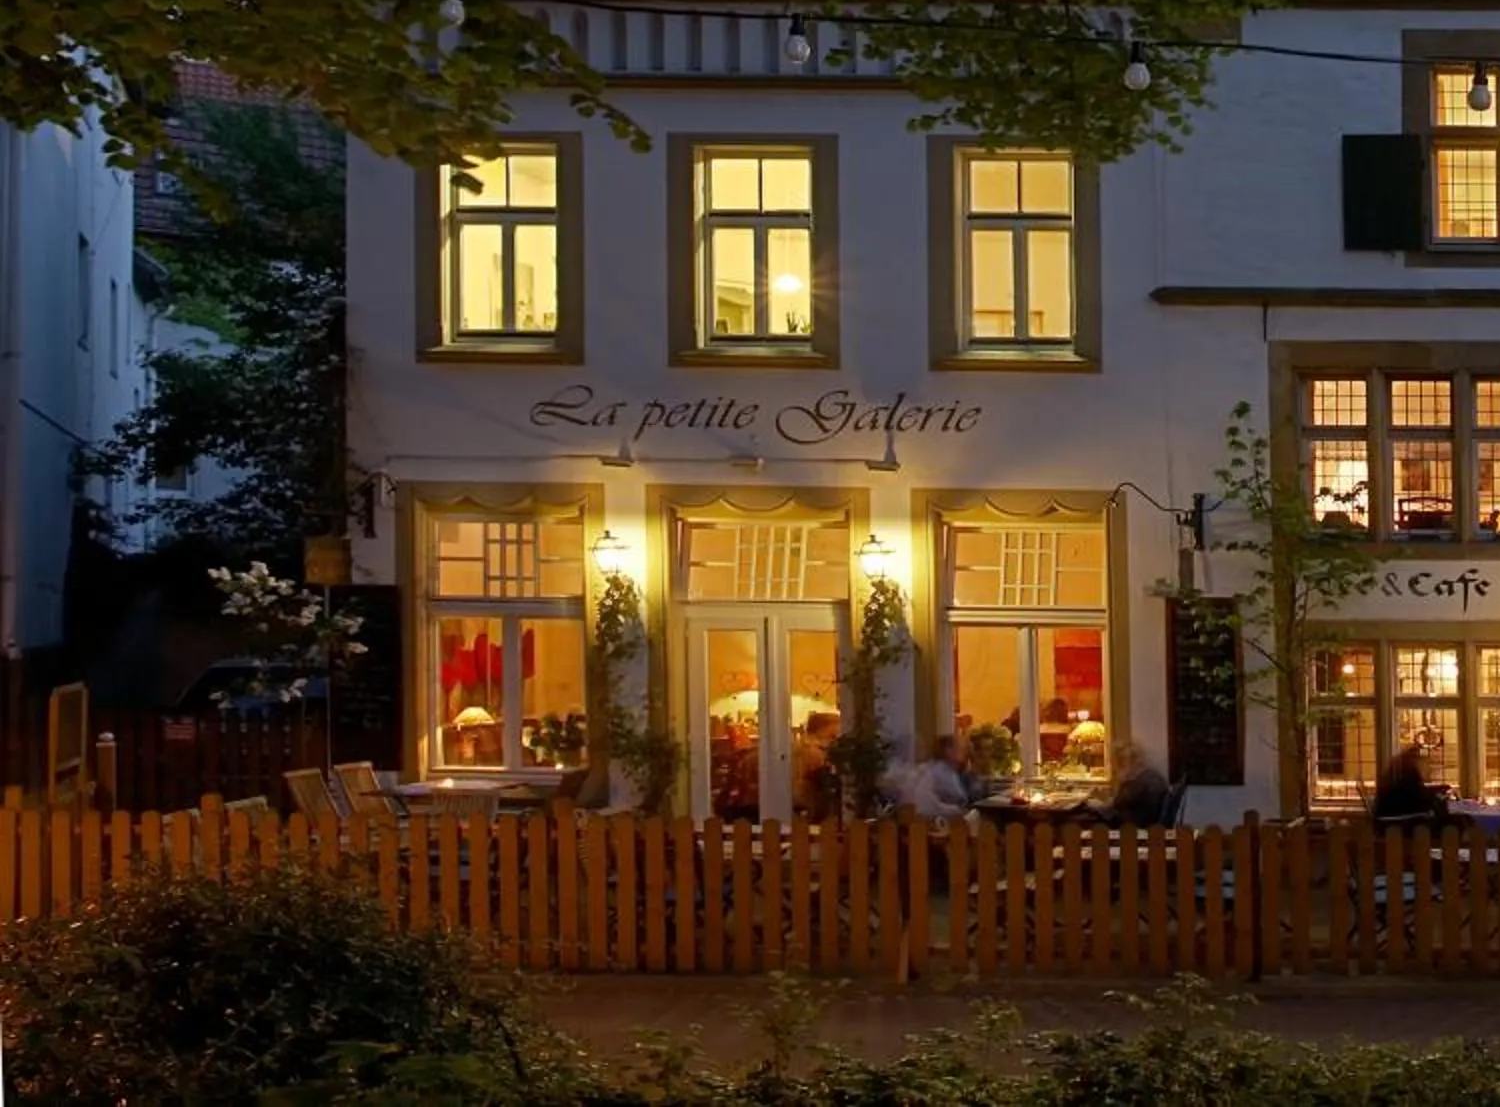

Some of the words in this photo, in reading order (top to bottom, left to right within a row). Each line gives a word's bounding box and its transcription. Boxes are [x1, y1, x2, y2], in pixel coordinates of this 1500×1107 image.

[529, 384, 627, 428] La
[632, 396, 760, 442] petite
[775, 389, 982, 445] Galerie
[1381, 572, 1402, 597] &
